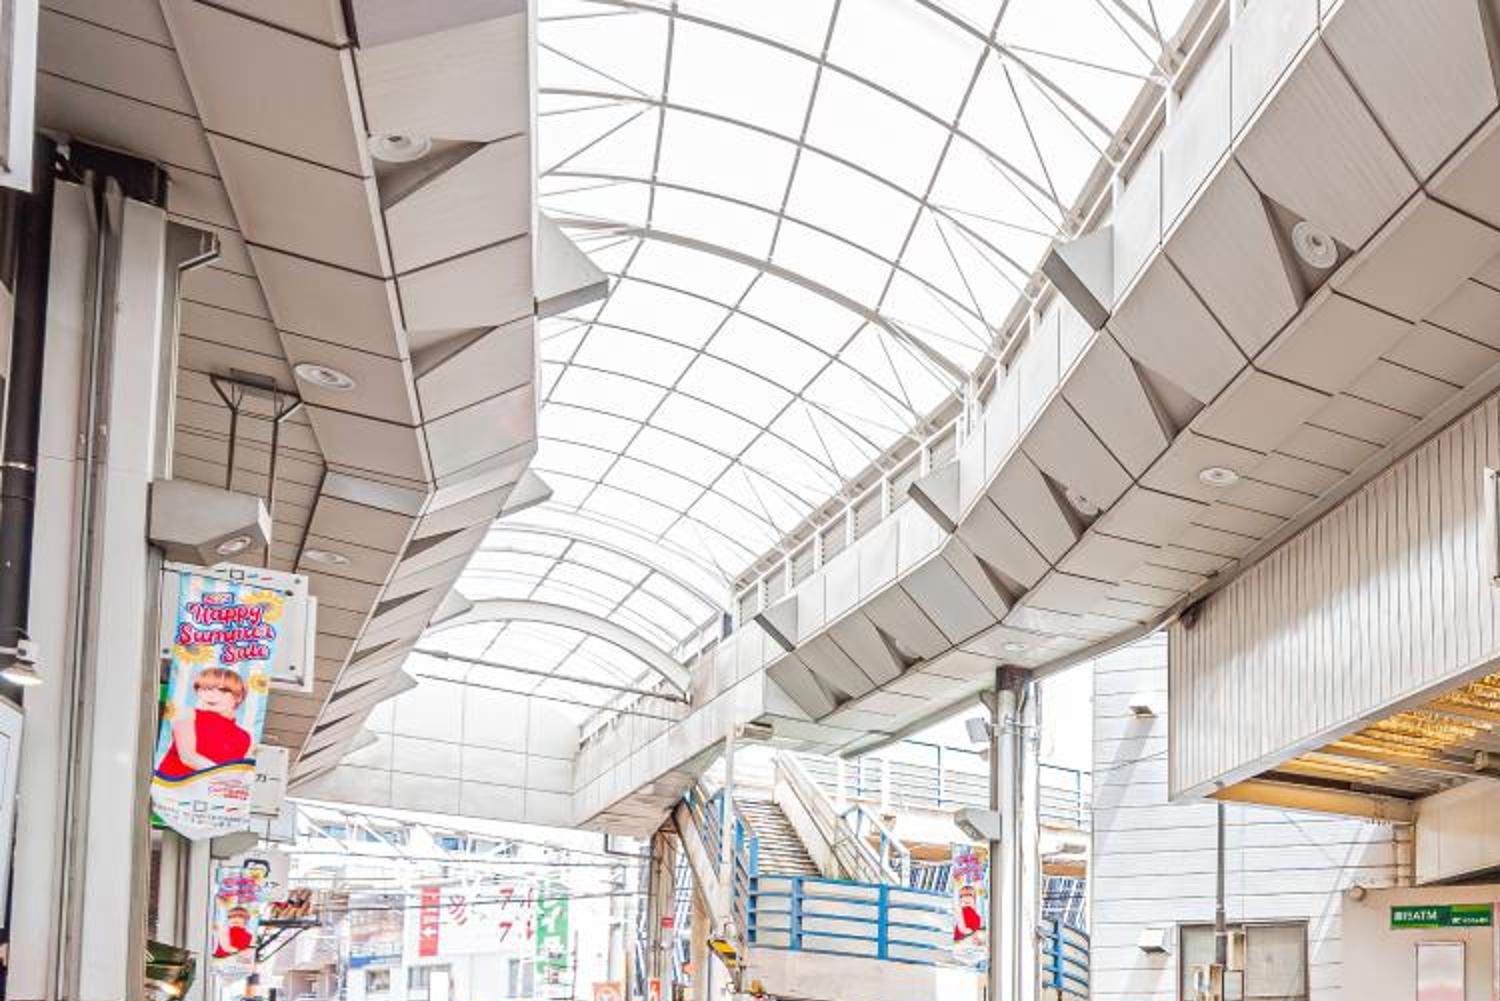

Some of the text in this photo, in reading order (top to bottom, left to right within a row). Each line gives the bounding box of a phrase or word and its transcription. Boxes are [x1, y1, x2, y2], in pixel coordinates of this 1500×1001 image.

[190, 603, 262, 624] Happy
[179, 623, 275, 646] Summer
[222, 642, 267, 665] Sale
